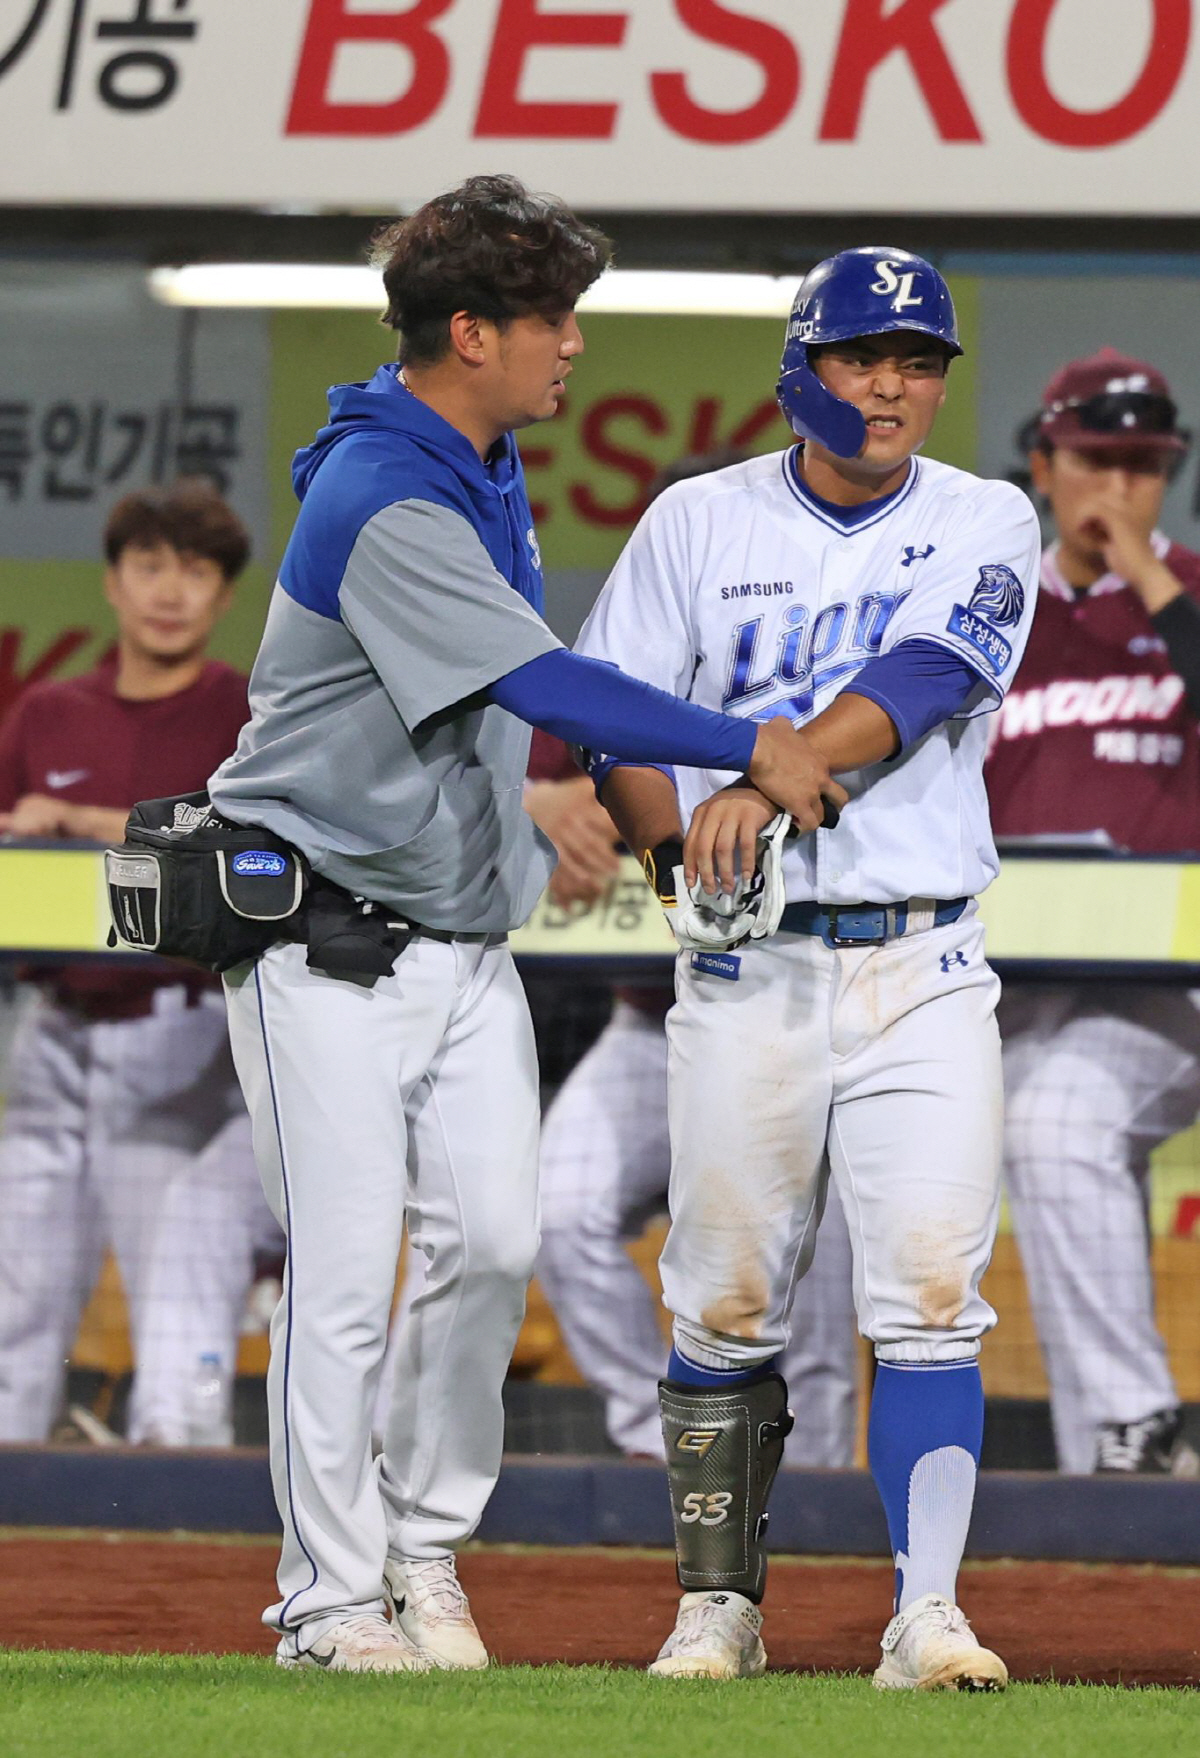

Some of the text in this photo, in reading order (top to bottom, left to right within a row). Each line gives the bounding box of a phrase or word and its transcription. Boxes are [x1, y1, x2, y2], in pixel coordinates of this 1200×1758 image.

[869, 260, 923, 313] SL
[721, 581, 794, 600] SAMSUNG
[722, 588, 913, 709] Lion
[960, 613, 1011, 668] 삼성생명
[681, 1491, 733, 1526] 53
